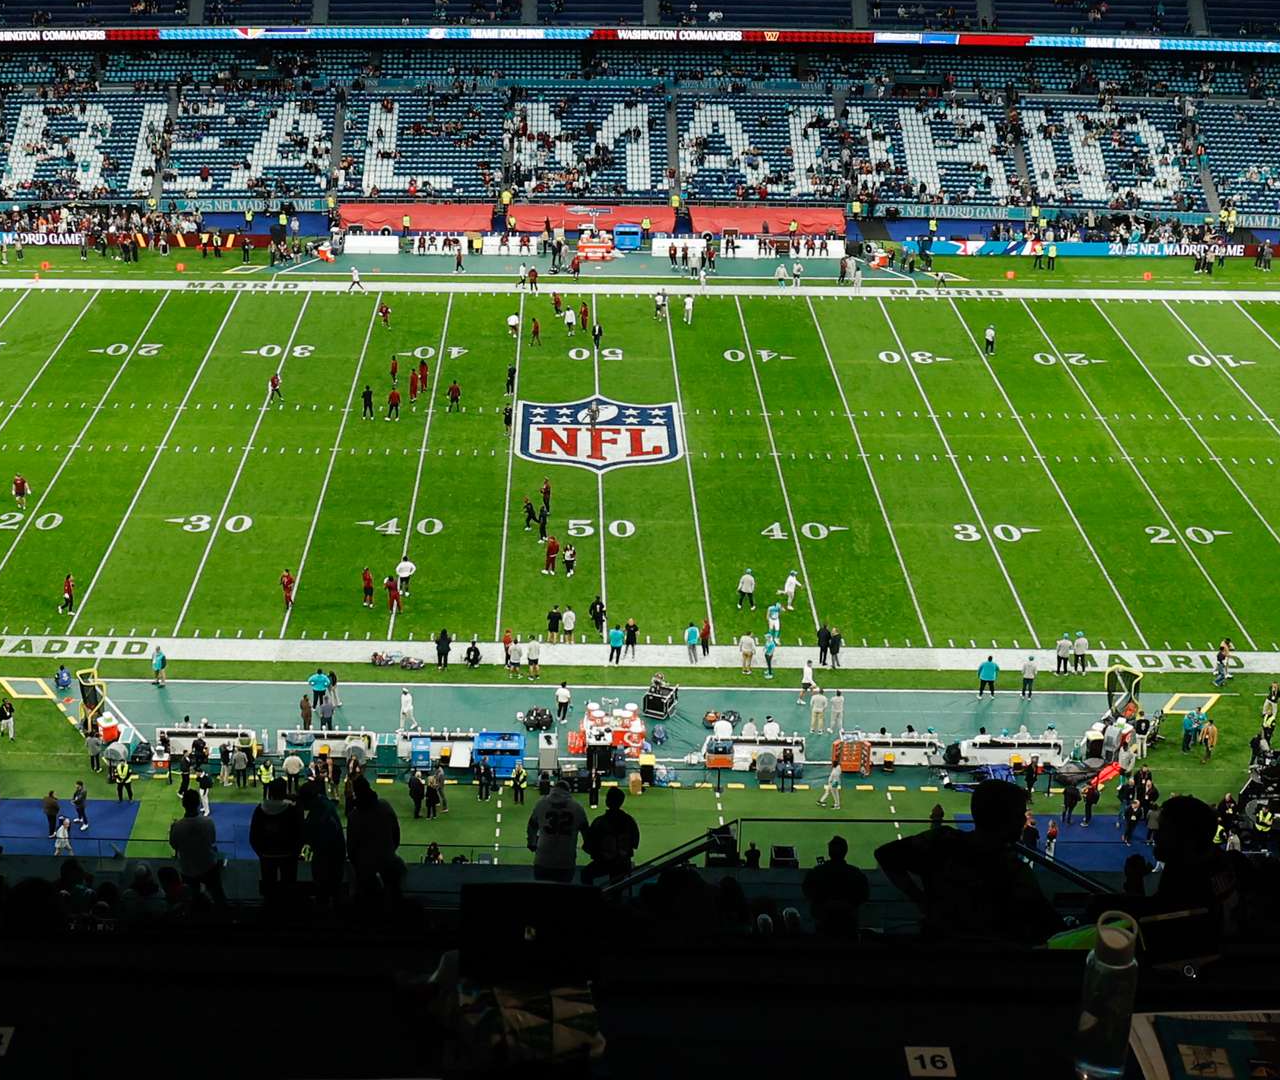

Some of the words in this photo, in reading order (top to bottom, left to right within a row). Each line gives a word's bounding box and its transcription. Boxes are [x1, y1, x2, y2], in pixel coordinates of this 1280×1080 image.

[42, 30, 106, 41] COMMANDERS
[617, 30, 677, 41] WASHINGTON
[679, 30, 742, 41] COMMANDERS
[3, 102, 454, 192] REAL
[184, 200, 213, 212] 2025
[214, 200, 236, 212] NFL
[877, 205, 904, 218] 25
[906, 205, 929, 218] NFL
[929, 205, 974, 219] MADRID
[976, 206, 1008, 219] GAME
[1139, 244, 1161, 256] NFL
[1209, 244, 1245, 257] GME
[186, 281, 299, 290] MADRID
[888, 288, 1005, 296] MADRID
[535, 426, 663, 461] NFL
[184, 513, 252, 534] 30
[372, 516, 443, 537] 40
[567, 517, 637, 539] 50
[761, 520, 829, 541] 40
[953, 523, 1022, 543] 30
[1144, 525, 1216, 545] 20
[914, 1054, 948, 1069] 16
